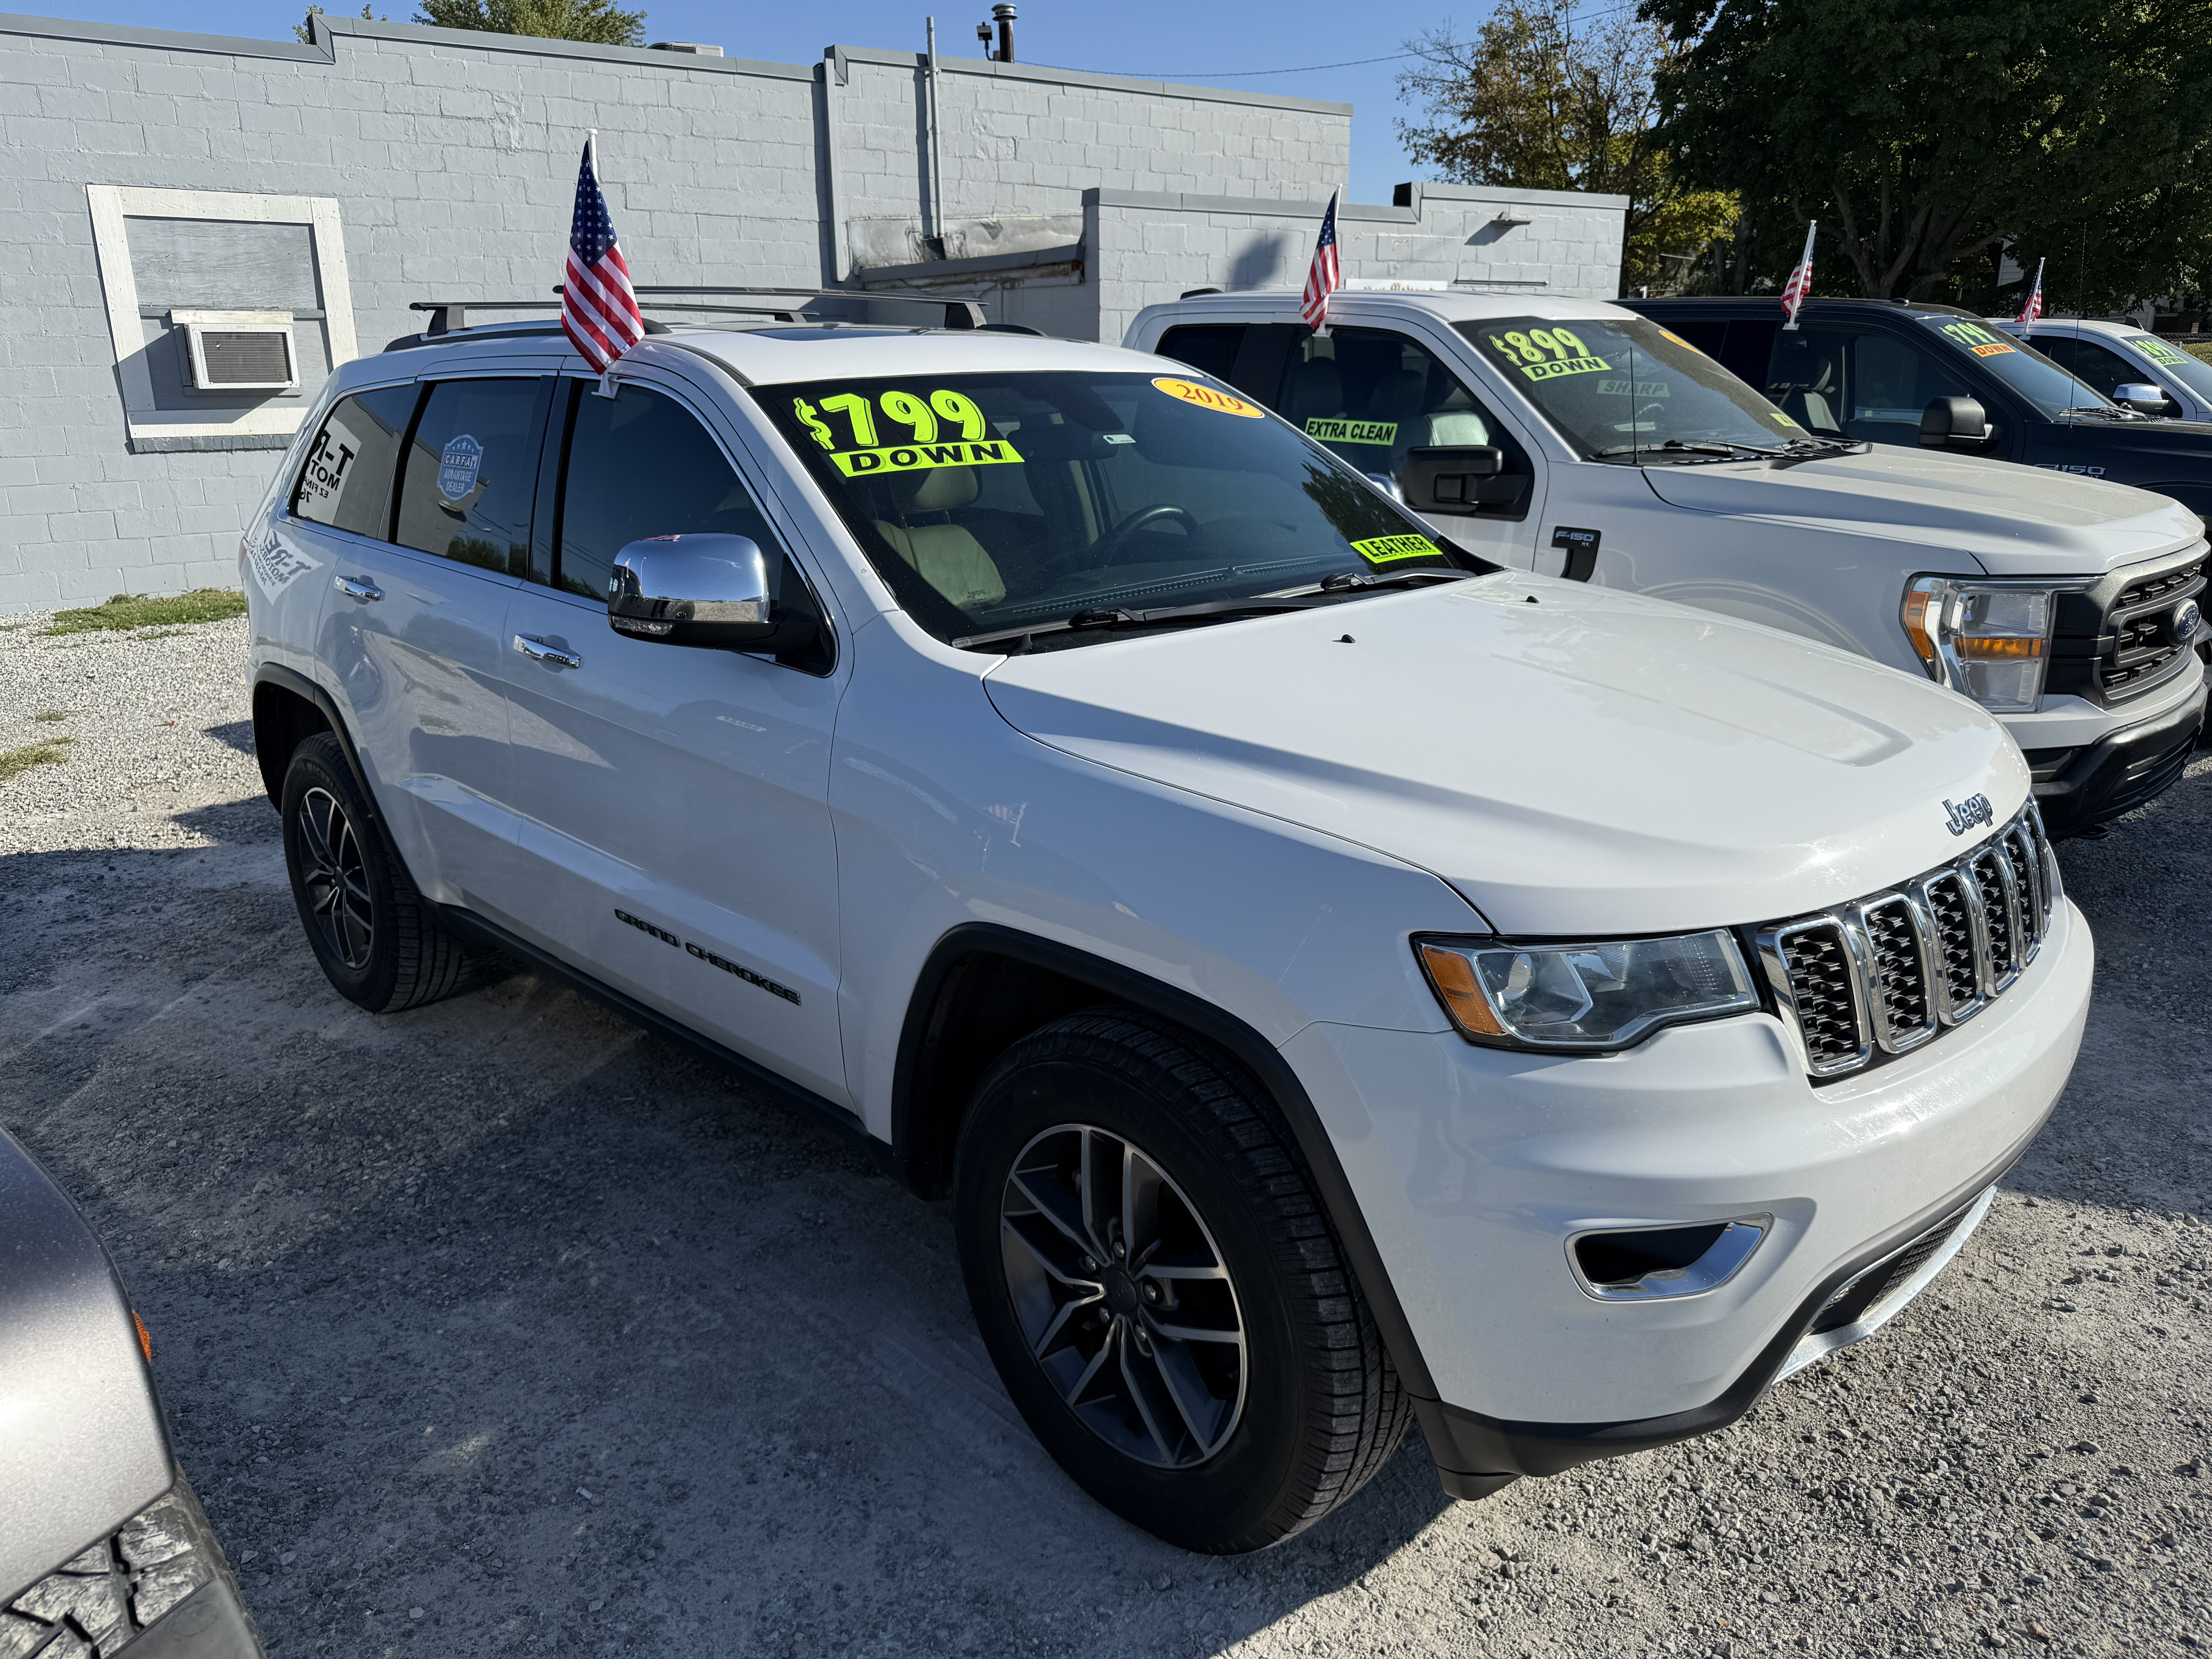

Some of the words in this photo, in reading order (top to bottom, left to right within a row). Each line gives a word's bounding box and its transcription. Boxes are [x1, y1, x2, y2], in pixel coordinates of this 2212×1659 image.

[1938, 322, 1999, 346] $799
[1489, 327, 1590, 367] $899
[1975, 344, 2012, 355] DOWN
[2130, 340, 2176, 357] $899
[1529, 358, 1604, 378] DOWN
[2157, 356, 2185, 365] DOWN
[1176, 384, 1243, 410] 2019
[1603, 381, 1665, 395] SHARP
[793, 390, 986, 450] $799
[1306, 421, 1347, 438] EXTRA
[1351, 424, 1395, 441] CLEAN
[445, 454, 476, 469] CARFAX
[850, 443, 1006, 473] DOWN
[443, 468, 472, 482] ADVANTAGE
[446, 481, 465, 493] DEALER
[1555, 531, 1595, 542] F-150
[1359, 536, 1434, 558] LEATHER
[1941, 793, 1993, 836] Jeep
[614, 906, 681, 948] GRAND
[685, 940, 802, 1007] CHEROKEE
